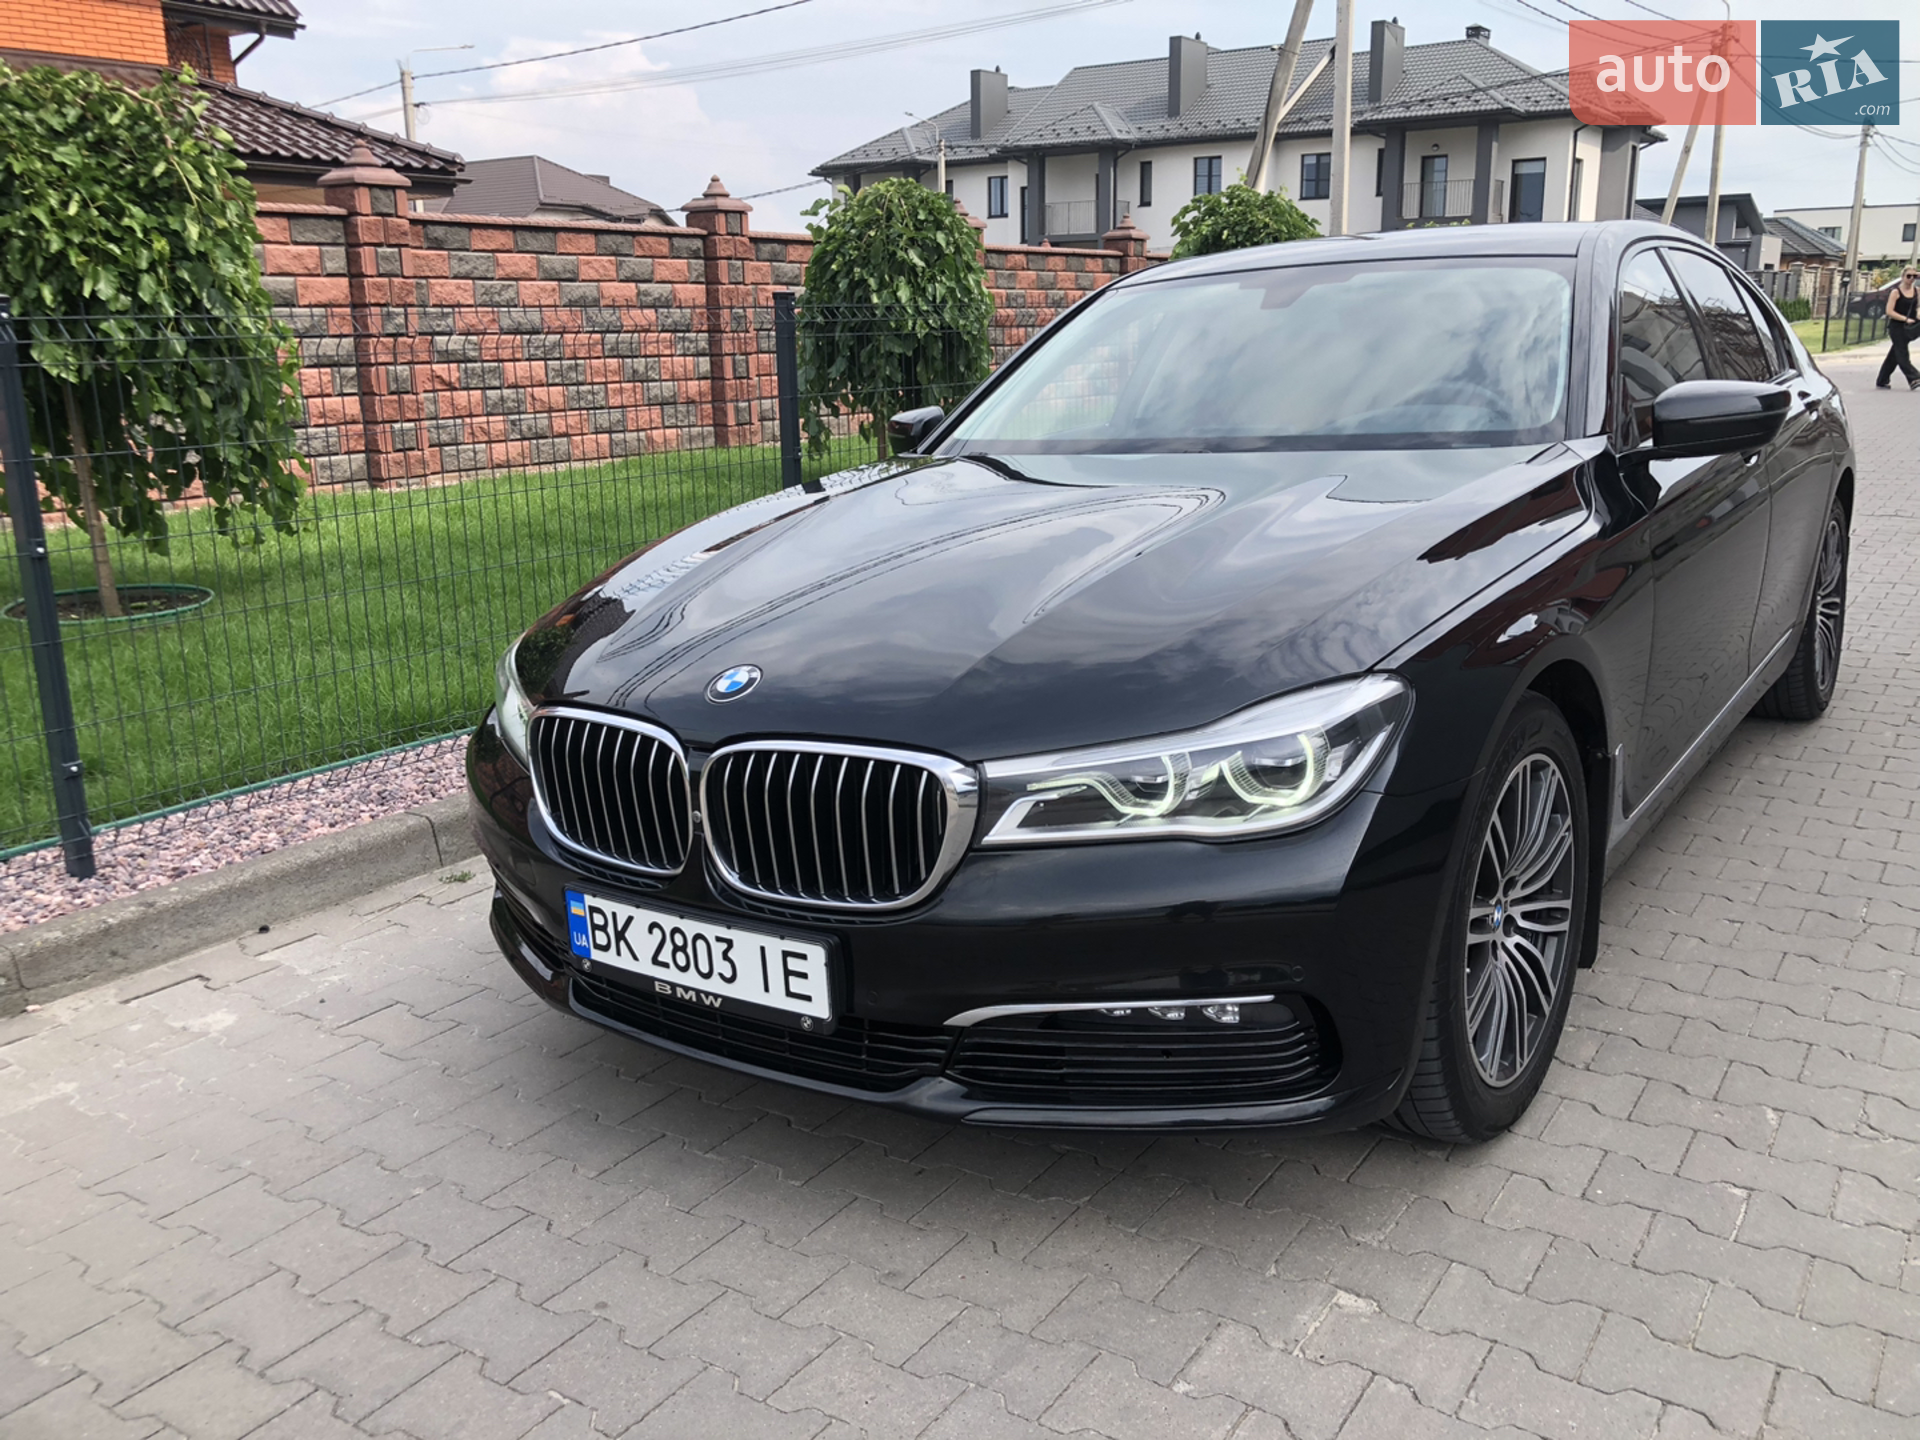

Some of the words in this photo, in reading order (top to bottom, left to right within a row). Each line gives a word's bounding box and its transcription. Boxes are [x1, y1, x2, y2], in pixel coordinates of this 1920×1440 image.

[573, 931, 588, 948] UA
[588, 905, 640, 962] BK
[648, 921, 738, 984] 2803
[760, 945, 813, 1002] IE
[654, 981, 723, 1008] BMW
